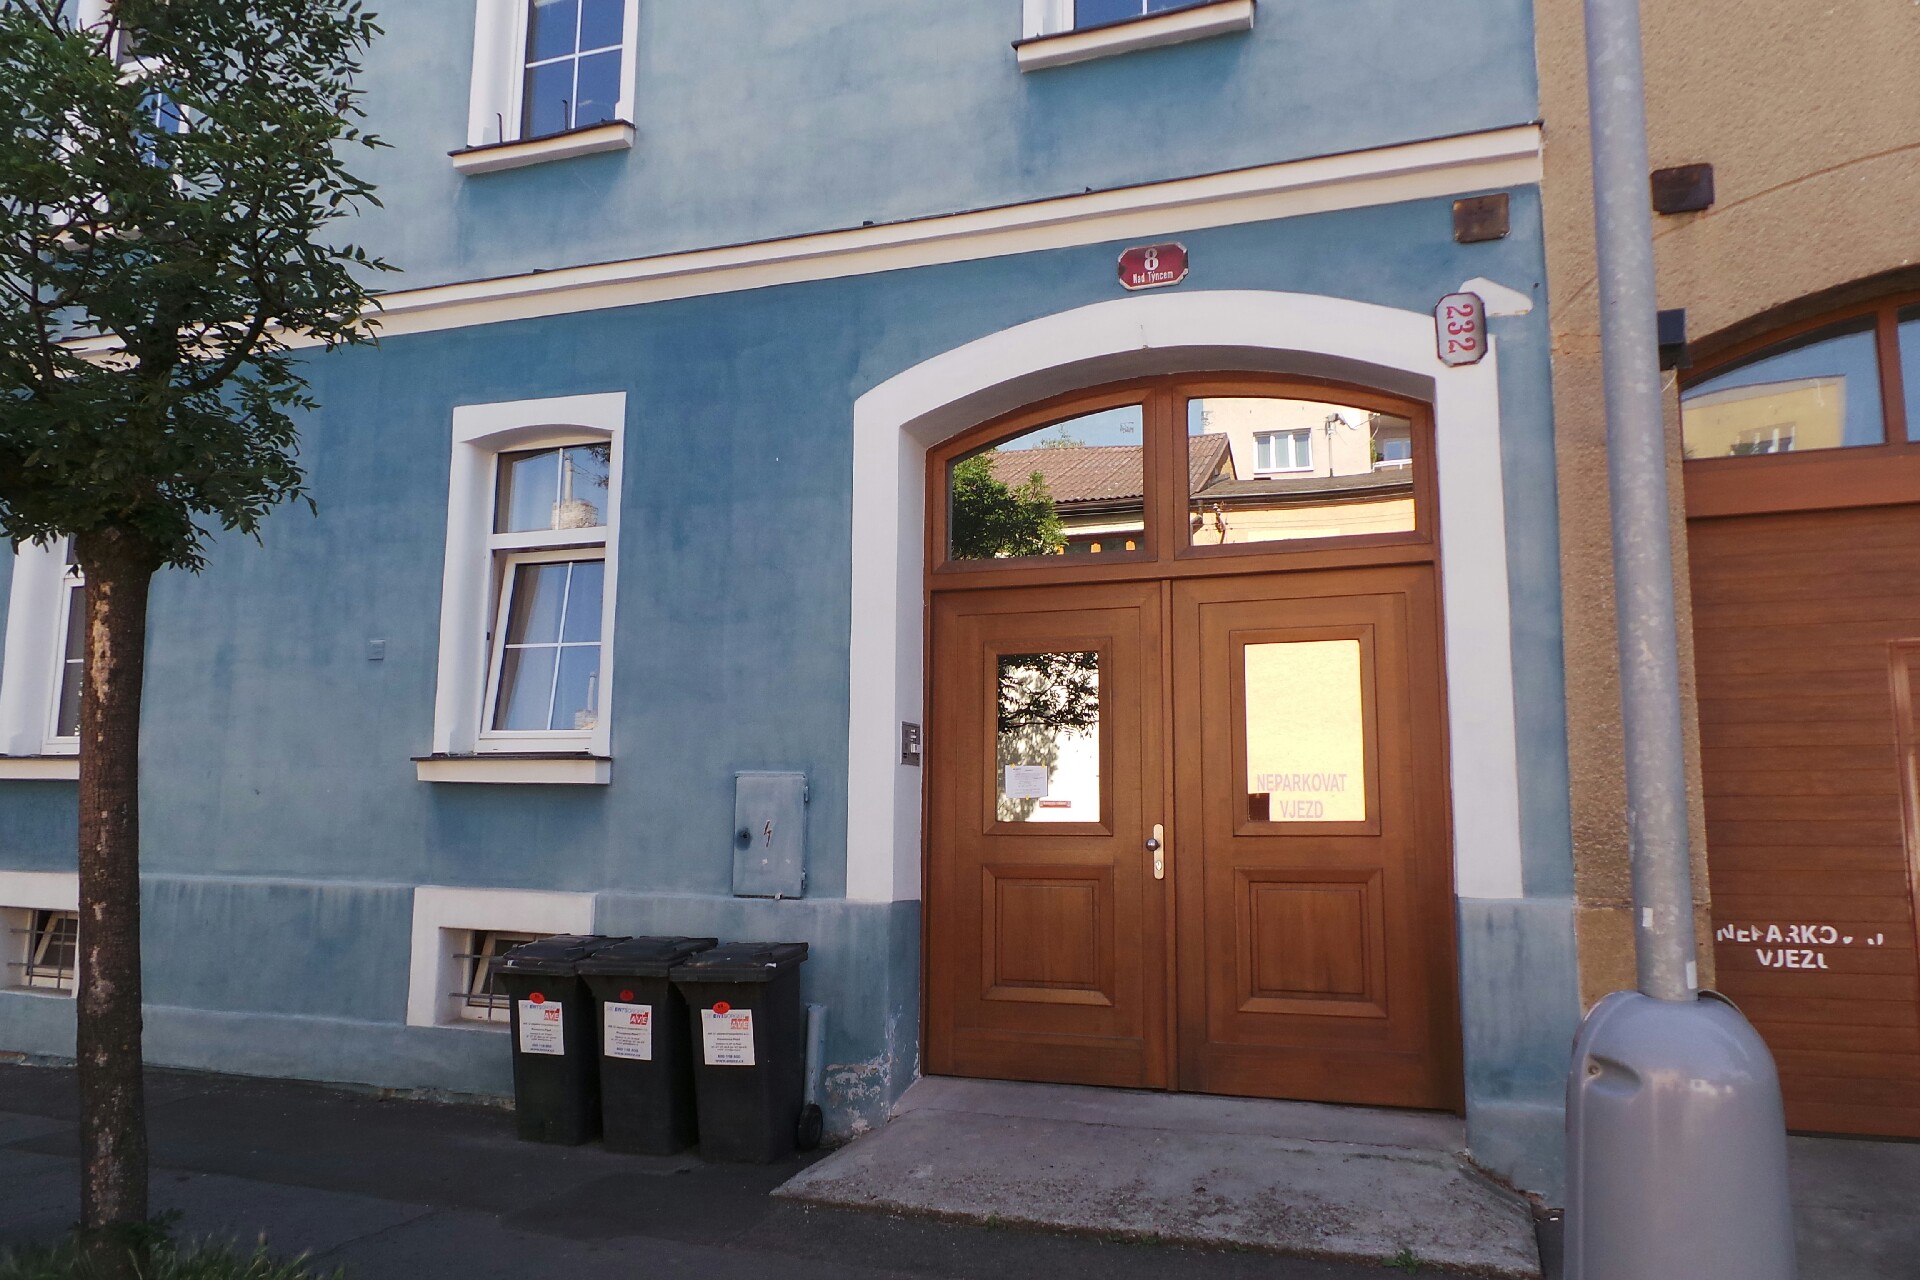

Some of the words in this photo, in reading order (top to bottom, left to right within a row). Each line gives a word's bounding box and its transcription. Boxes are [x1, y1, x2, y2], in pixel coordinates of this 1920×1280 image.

[1144, 247, 1159, 271] 8
[1132, 273, 1146, 284] Nad
[1147, 270, 1174, 283] Týncem
[1446, 303, 1477, 354] 232
[1256, 773, 1347, 792] NEPARKOVAT
[1279, 799, 1324, 819] VJEZD
[1716, 923, 1884, 946] NEPARKO
